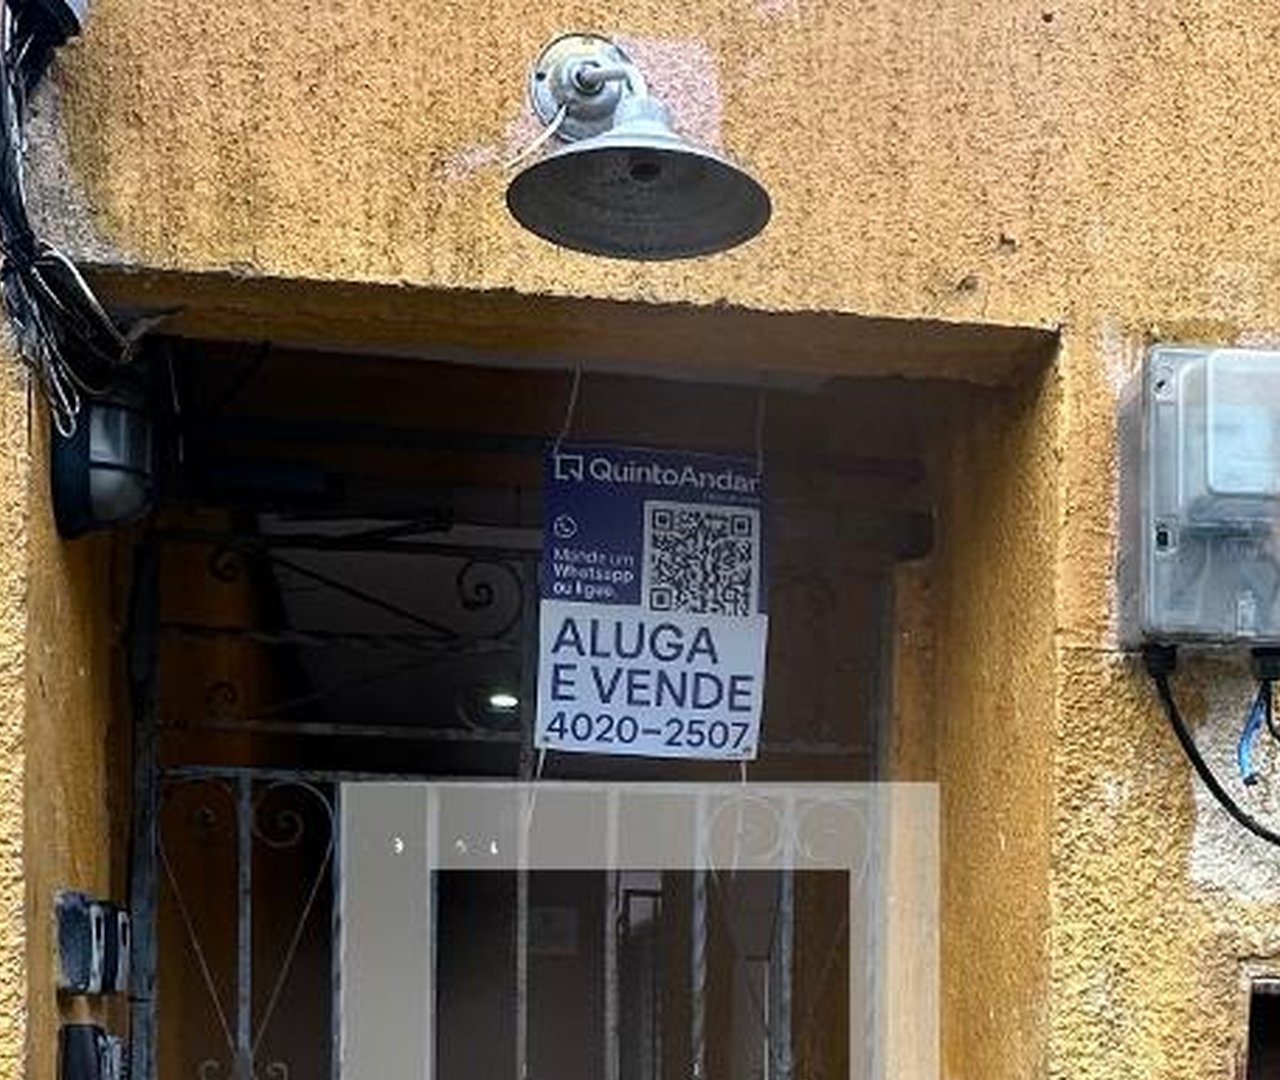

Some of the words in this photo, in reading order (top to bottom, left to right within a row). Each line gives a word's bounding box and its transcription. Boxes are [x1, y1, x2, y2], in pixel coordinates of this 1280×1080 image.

[589, 457, 760, 492] QuintoAndar
[553, 581, 573, 595] ou
[551, 618, 718, 664] ALUGA
[551, 663, 577, 701] E
[591, 666, 754, 711] VENDE
[545, 711, 750, 749] 4020-2507
